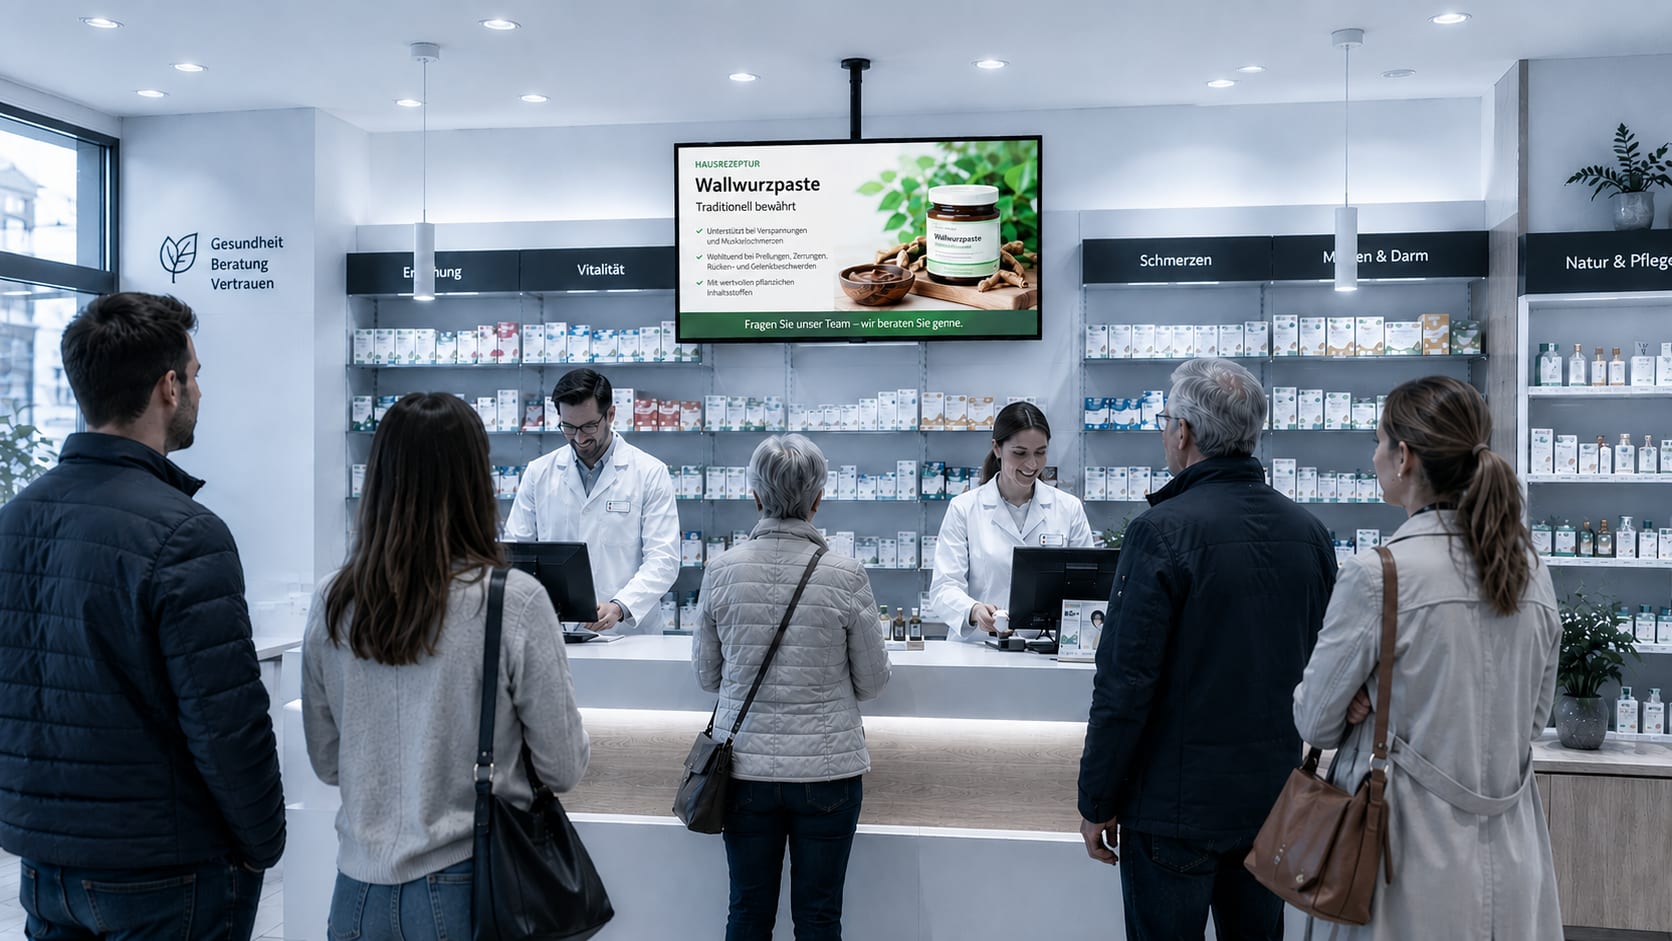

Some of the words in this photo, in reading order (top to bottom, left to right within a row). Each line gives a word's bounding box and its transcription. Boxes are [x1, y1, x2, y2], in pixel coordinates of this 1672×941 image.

[695, 160, 760, 168] HAUSREZEPTUR
[695, 176, 820, 196] Wallwurzpaste
[696, 201, 752, 212] Traditionell
[755, 201, 796, 212] bewährt
[745, 227, 756, 235] bei
[211, 236, 284, 250] Gesundheit
[1140, 253, 1212, 267] Schmerzen
[1323, 250, 1372, 263] Men
[1376, 249, 1387, 263] &
[1391, 249, 1429, 262] Darm
[1566, 256, 1609, 270] Natur
[1613, 254, 1626, 269] &
[211, 258, 269, 273] Beratung
[577, 263, 625, 276] Vitalität
[736, 263, 750, 271] und
[211, 278, 274, 290] Vertrauen
[744, 319, 777, 332] Fragen
[780, 319, 794, 329] Sie
[796, 320, 823, 329] unser
[824, 319, 851, 329] Team
[861, 318, 875, 328] wir
[877, 318, 914, 328] beraten
[916, 318, 931, 328] Sie
